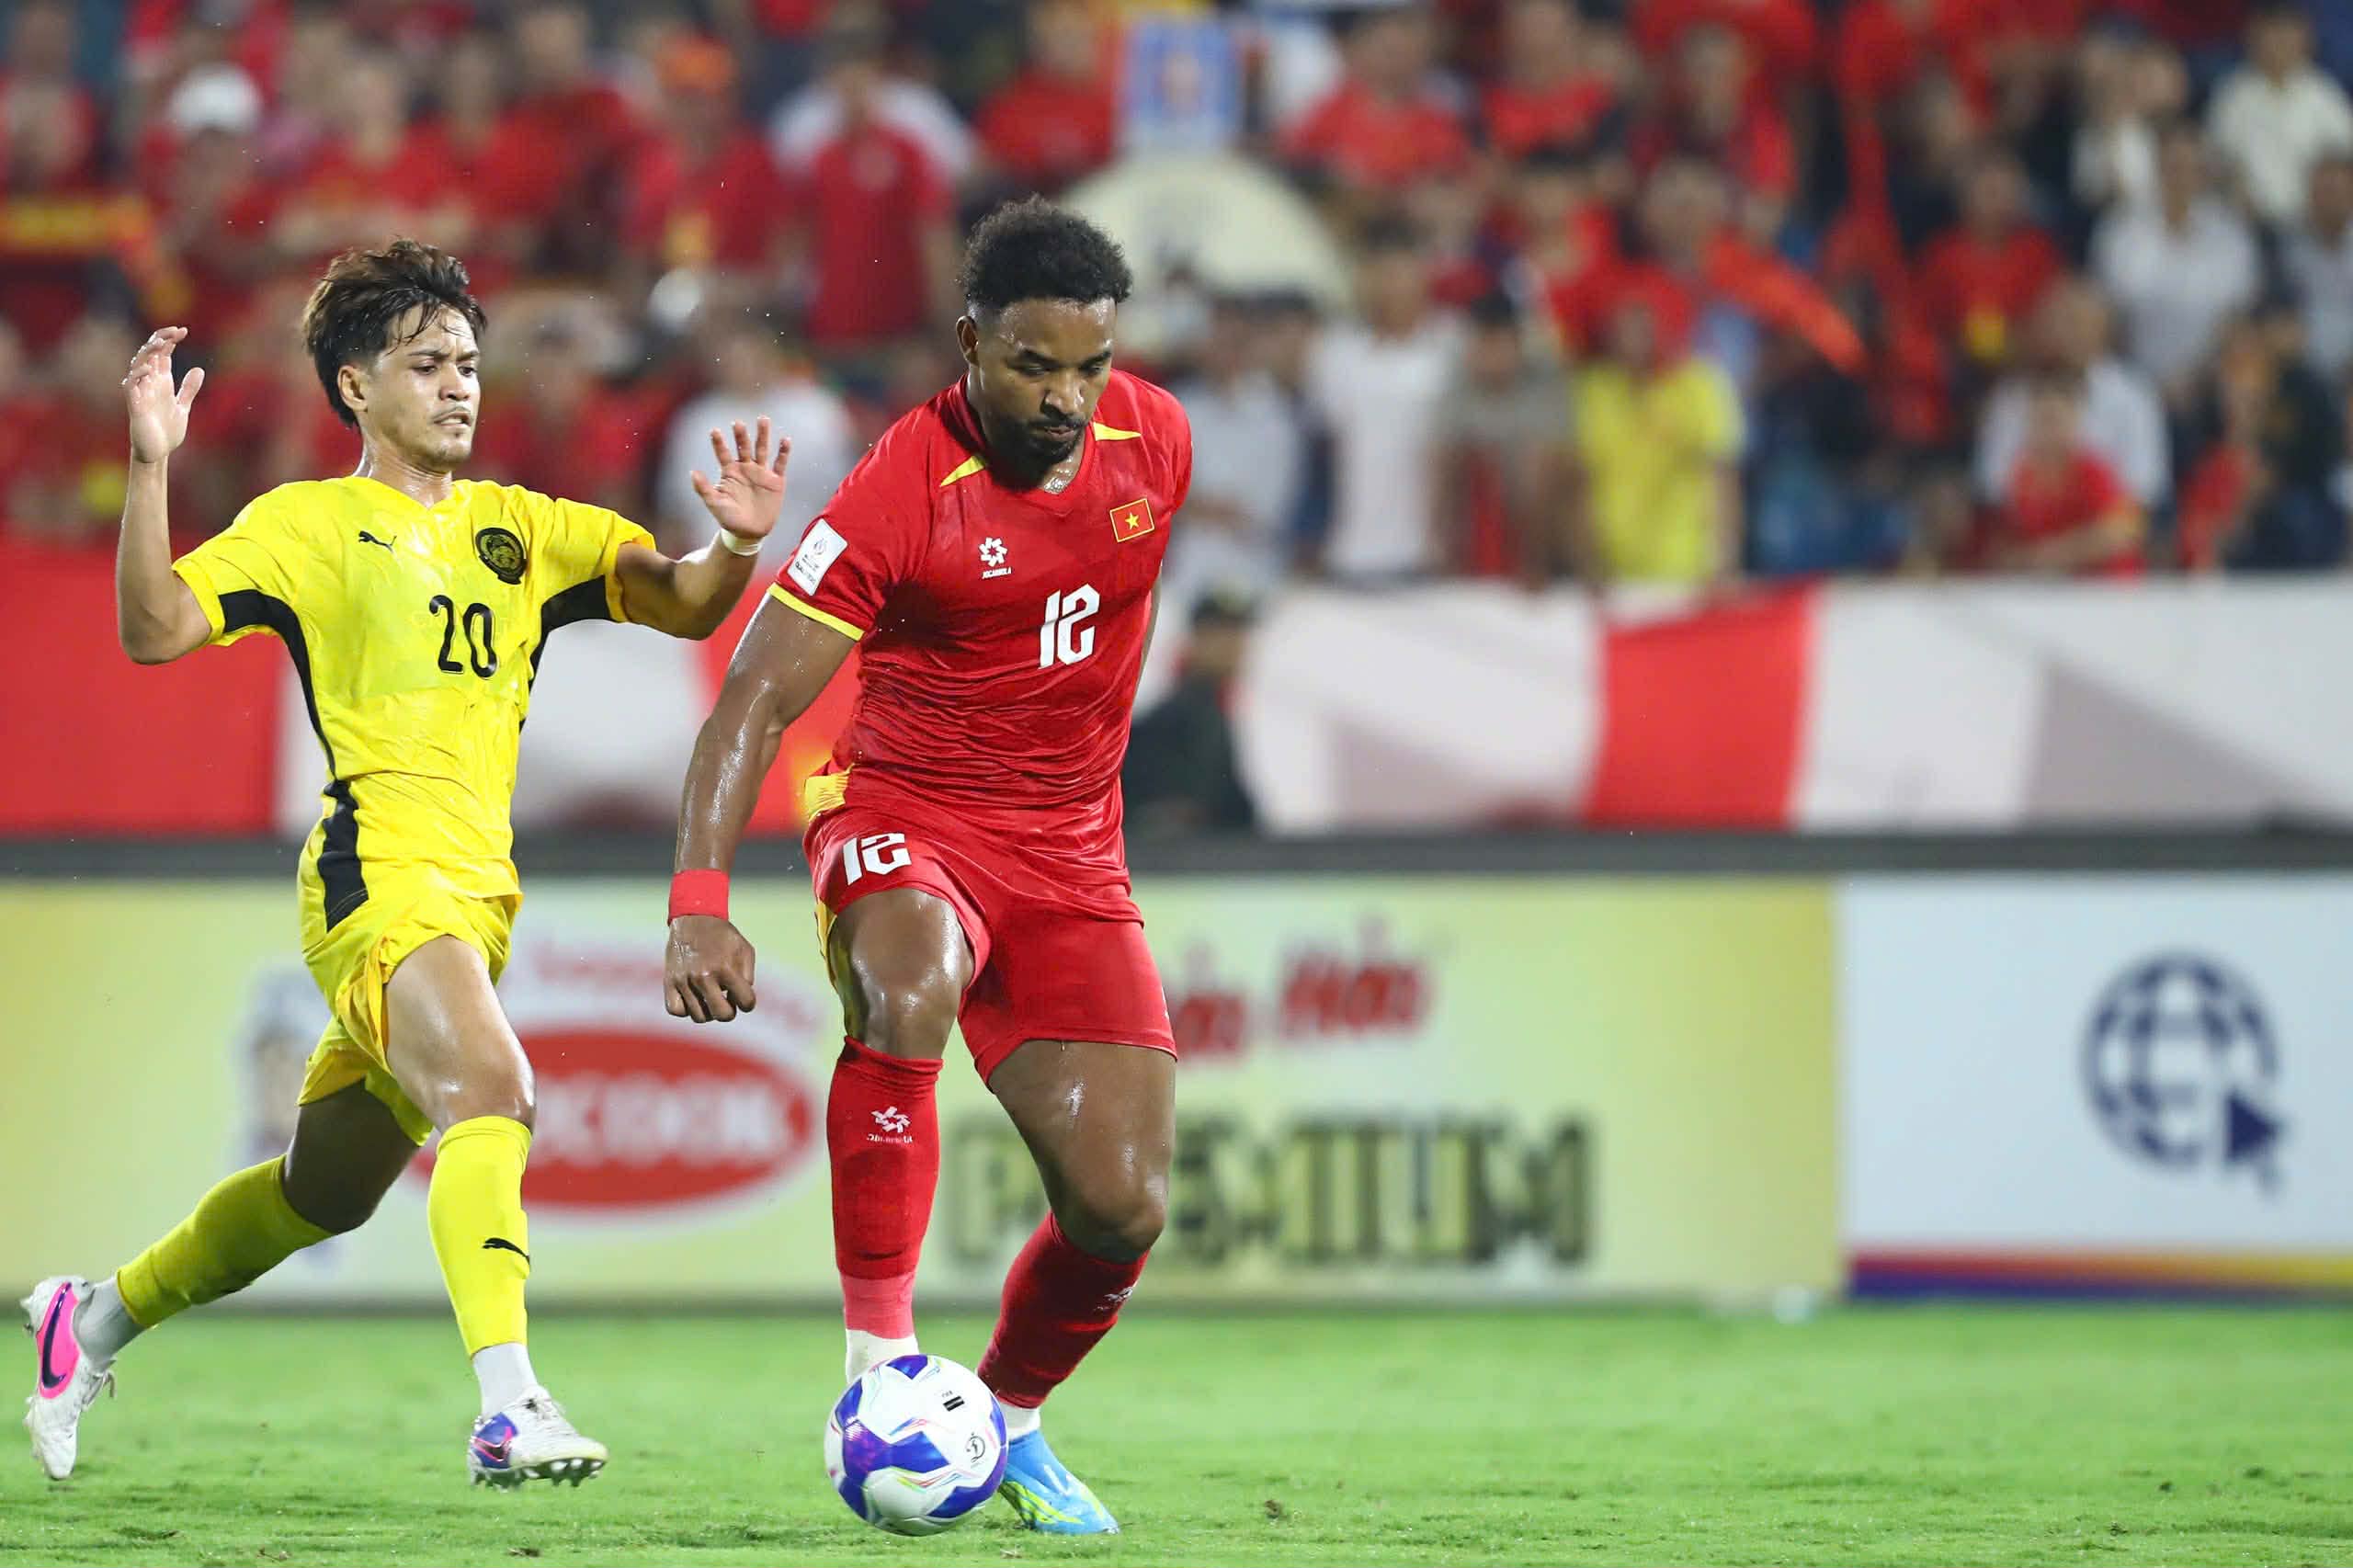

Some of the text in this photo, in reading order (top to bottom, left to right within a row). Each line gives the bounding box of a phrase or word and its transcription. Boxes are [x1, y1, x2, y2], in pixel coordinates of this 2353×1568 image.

[429, 595, 497, 678] 20
[1039, 584, 1100, 670] 12
[843, 833, 912, 886] 12
[949, 1112, 1592, 1265] PEMIUM
